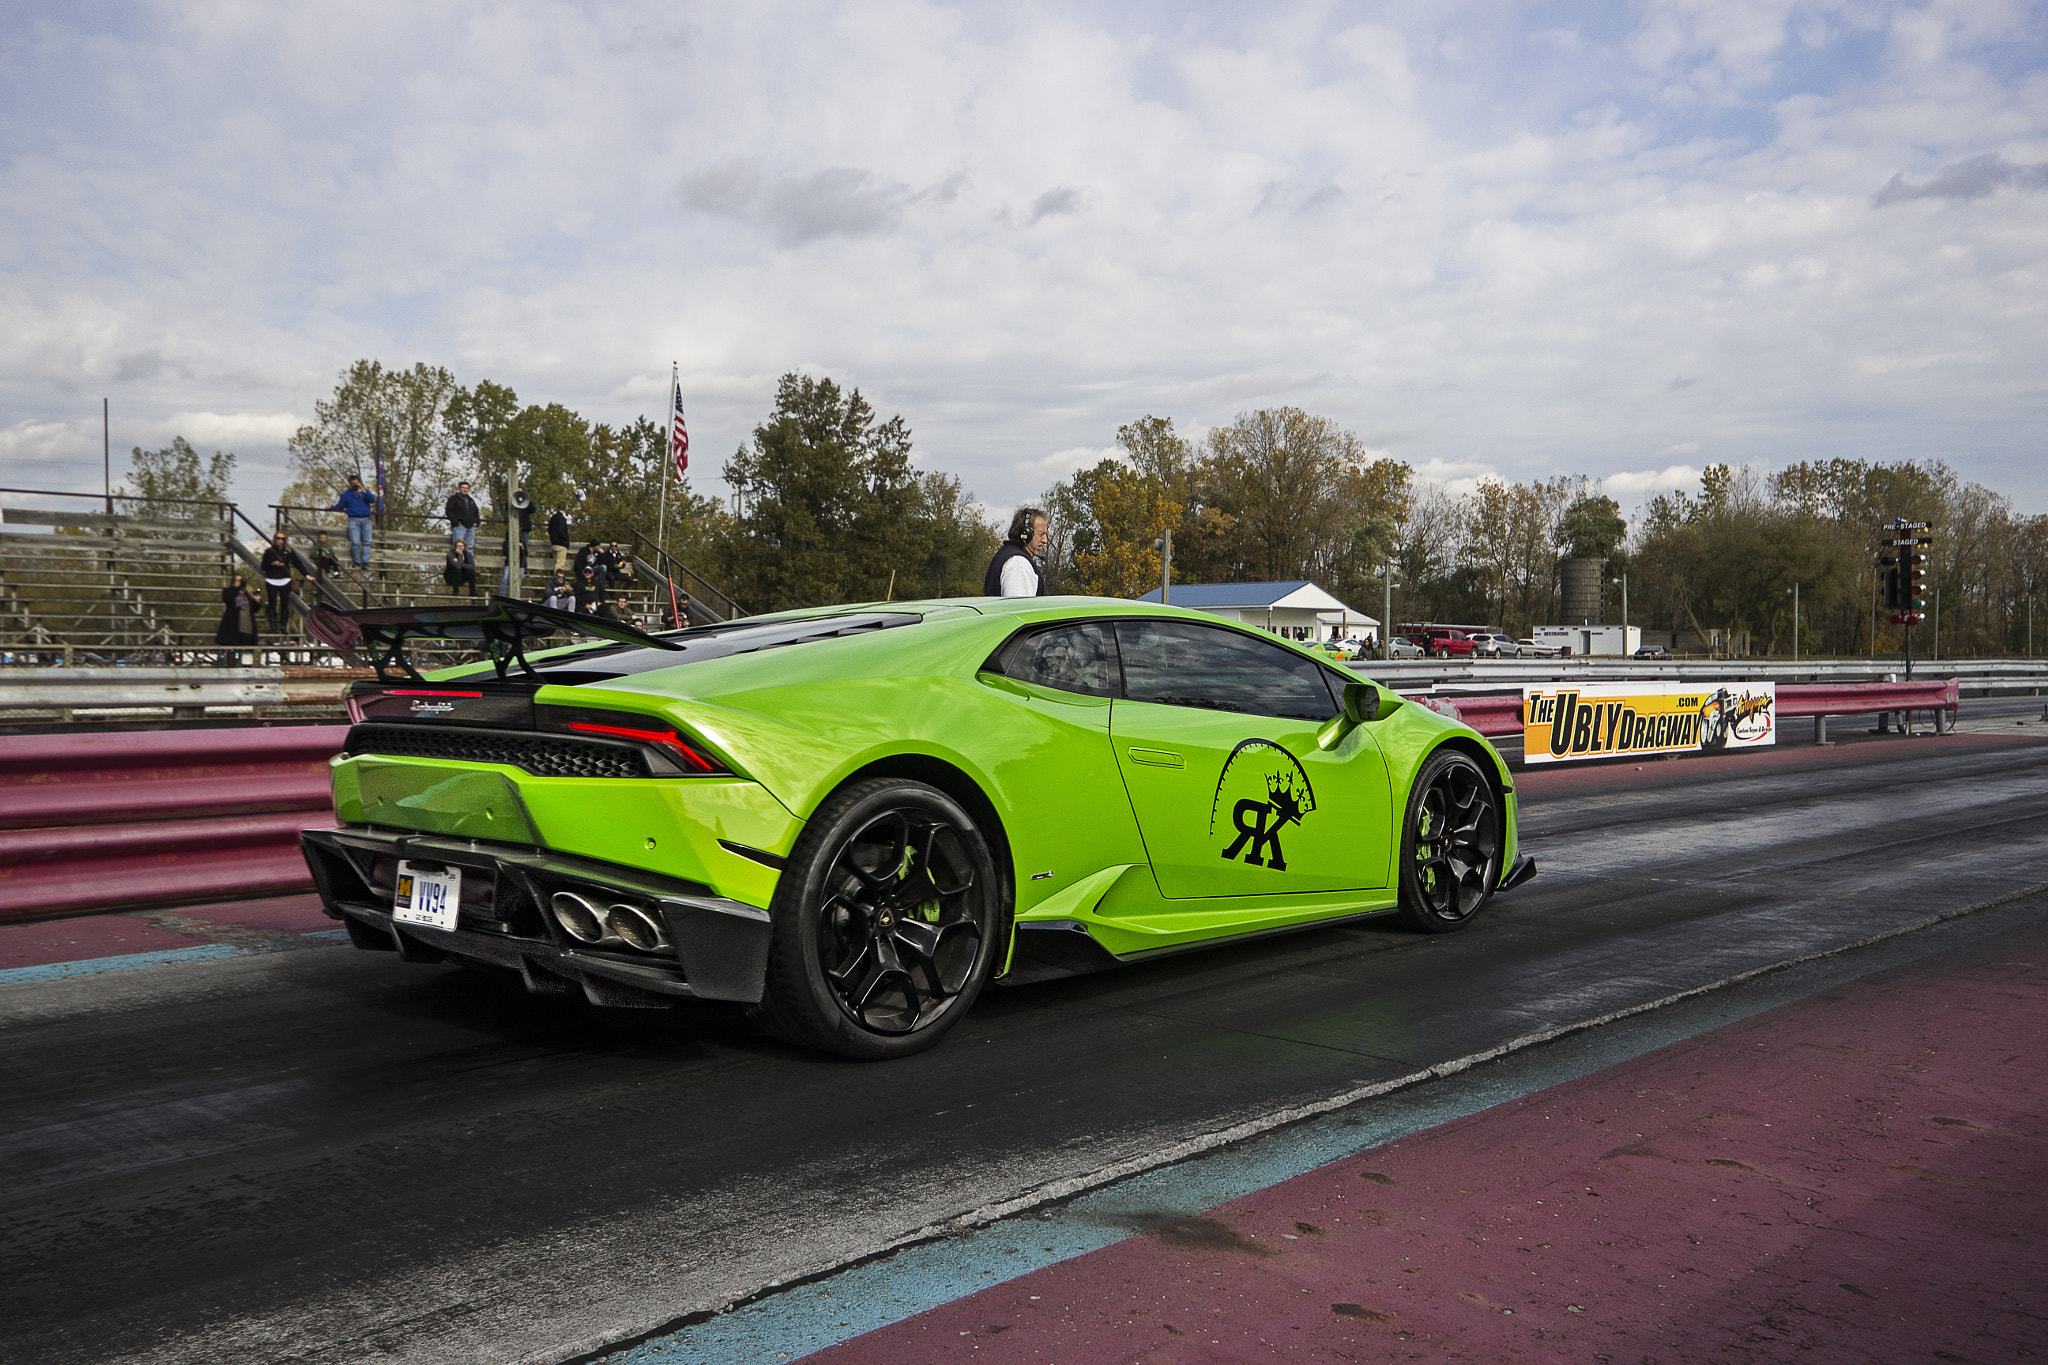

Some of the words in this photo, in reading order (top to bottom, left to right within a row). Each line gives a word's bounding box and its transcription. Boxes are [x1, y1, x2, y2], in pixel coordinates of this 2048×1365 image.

[1676, 697, 1699, 708] .COM
[1551, 693, 1624, 756] UBLY
[1619, 711, 1701, 750] DRAGWAY
